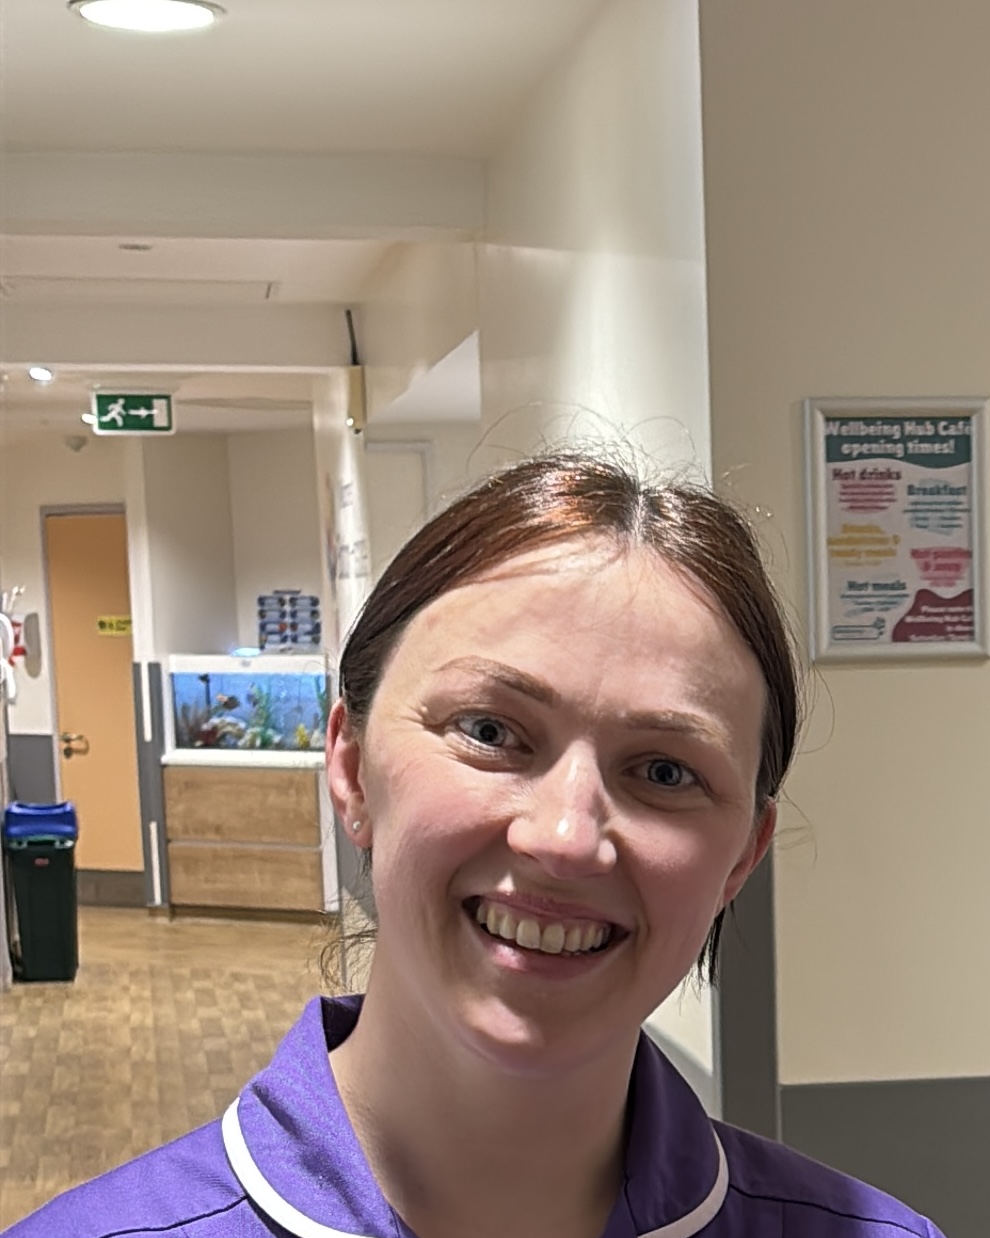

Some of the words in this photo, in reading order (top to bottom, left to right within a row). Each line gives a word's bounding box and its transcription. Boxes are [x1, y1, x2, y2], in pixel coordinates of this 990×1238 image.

[825, 421, 901, 439] Wellbeing
[903, 421, 935, 436] Hub
[841, 441, 904, 458] opening
[907, 439, 955, 455] times!
[832, 468, 856, 481] Hot
[859, 467, 902, 481] drinks
[907, 485, 967, 496] Breakfast
